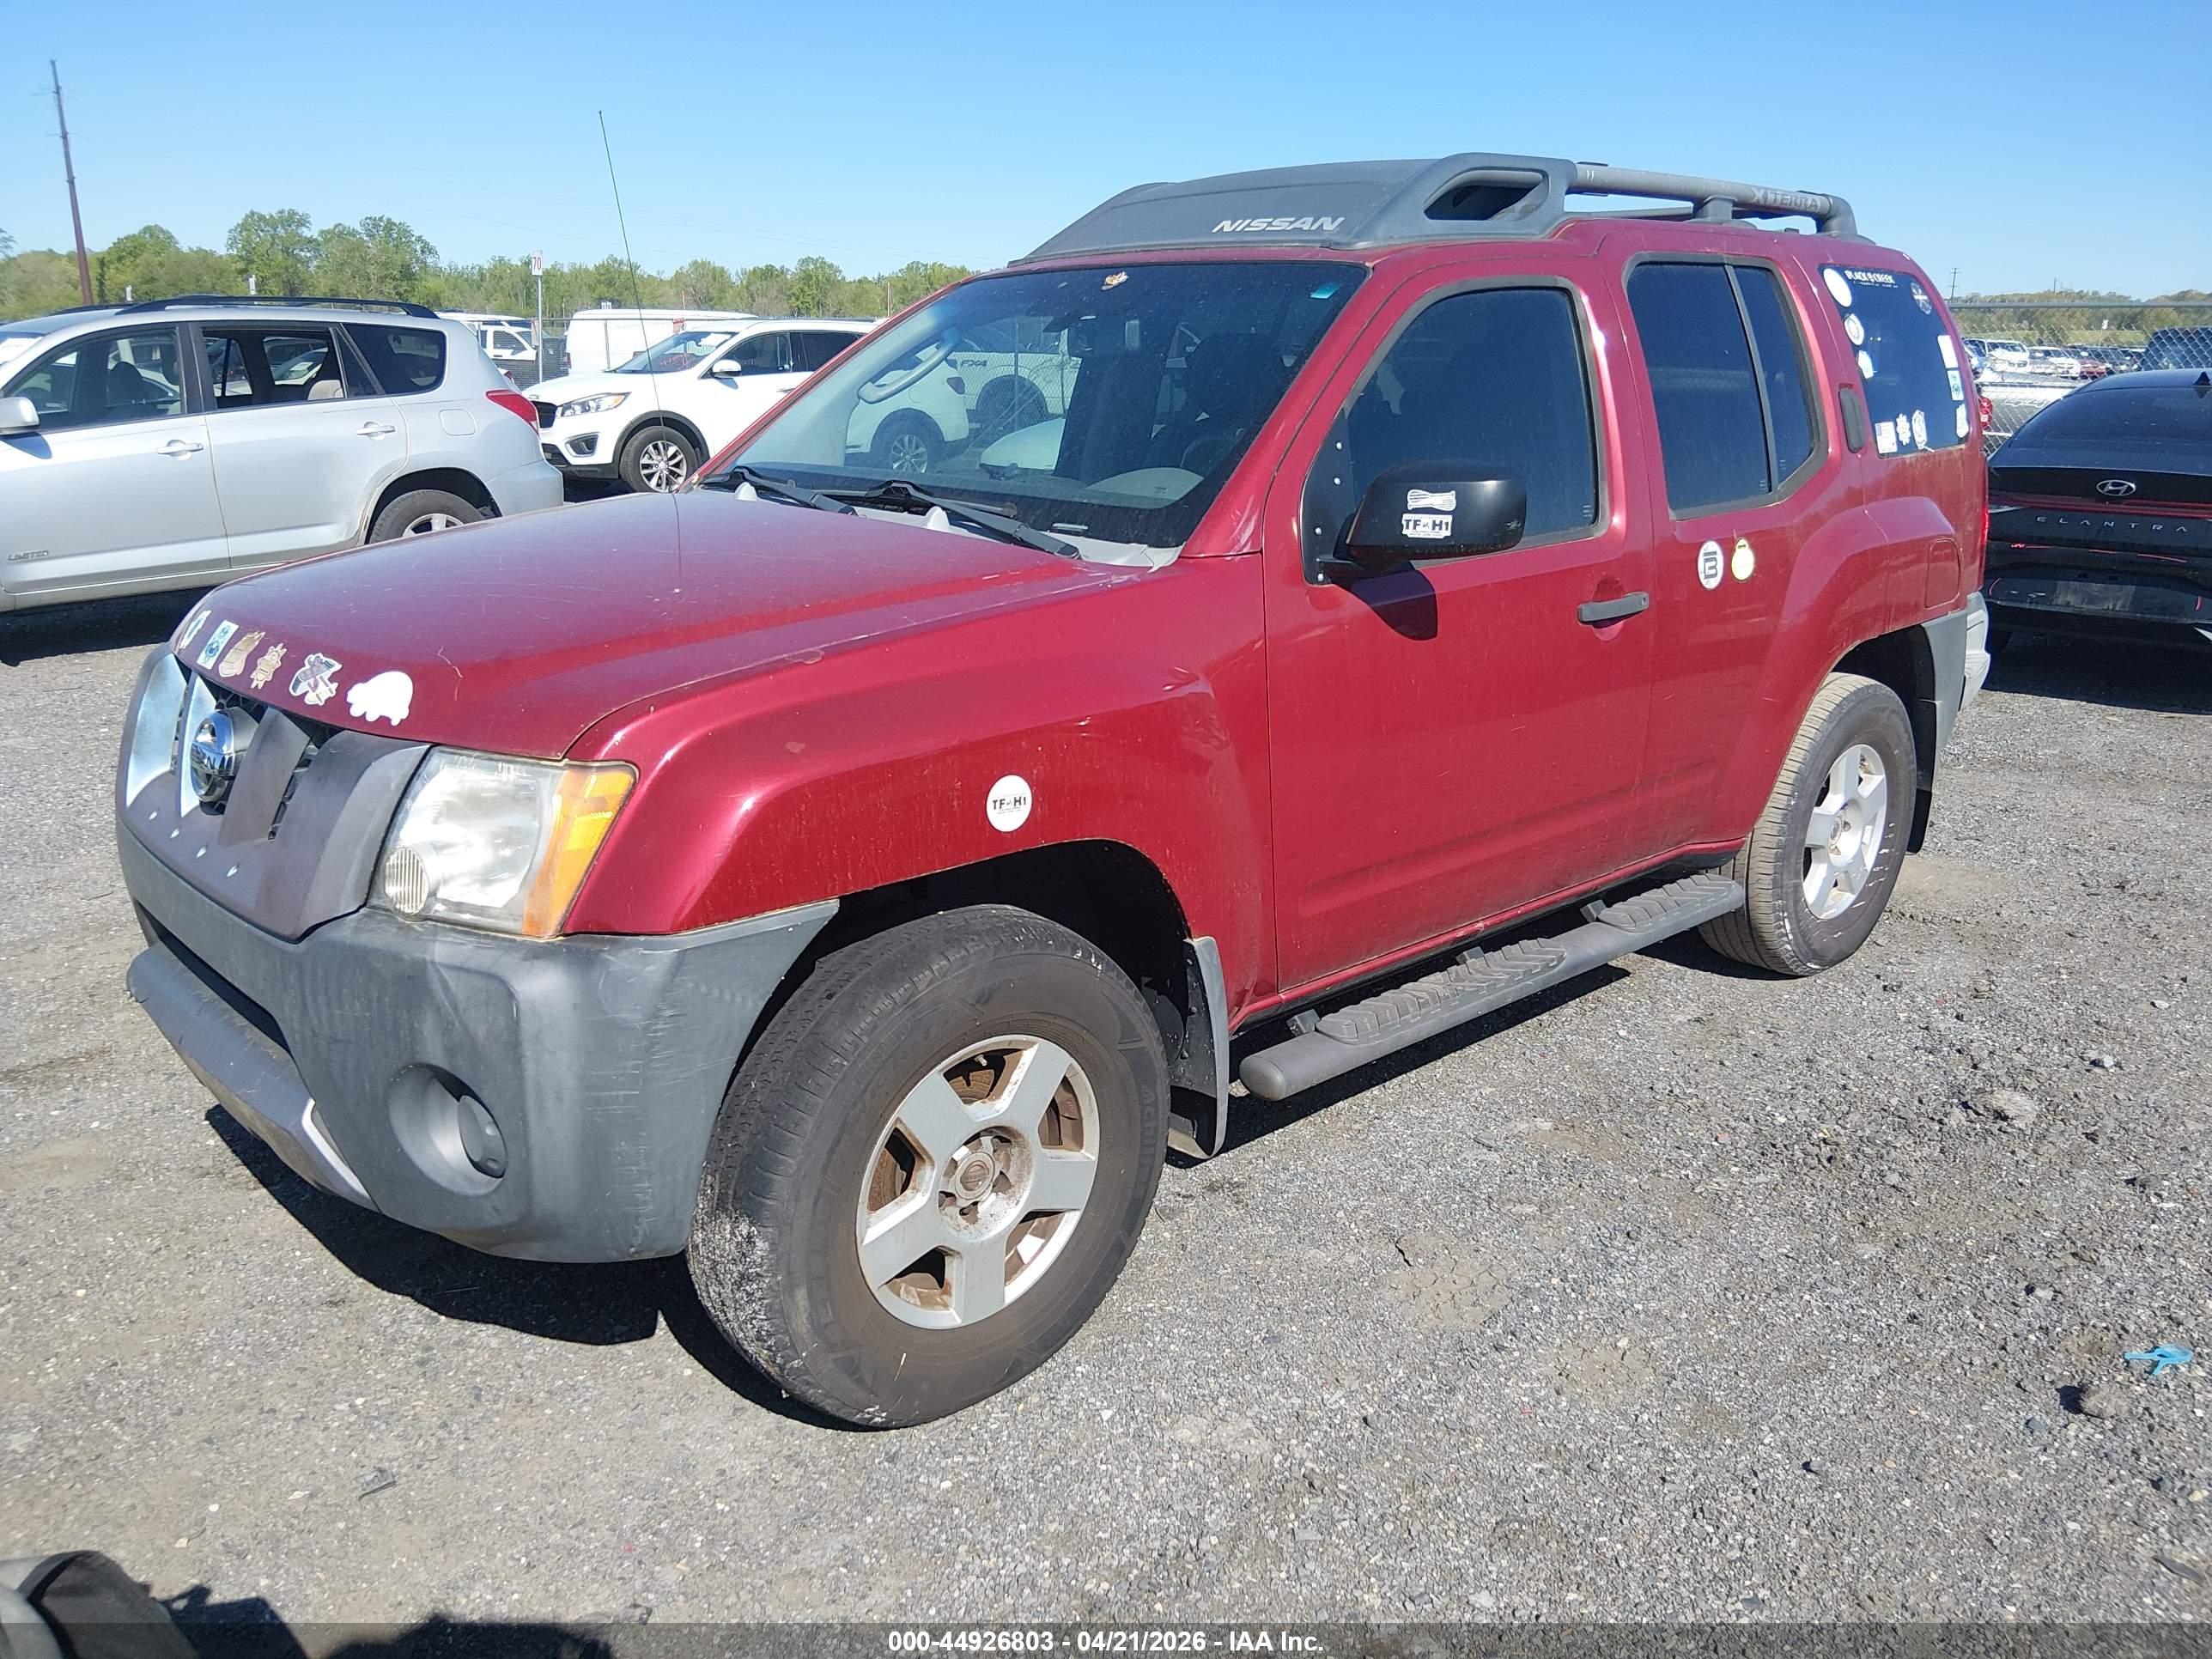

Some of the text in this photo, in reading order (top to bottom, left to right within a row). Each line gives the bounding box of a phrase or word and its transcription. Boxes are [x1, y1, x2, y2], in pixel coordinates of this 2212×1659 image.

[1212, 216, 1346, 233] NISSAN
[532, 257, 542, 270] 70
[1403, 519, 1422, 531] TF
[2036, 516, 2187, 533] ELANTRA
[992, 799, 1006, 811] TF
